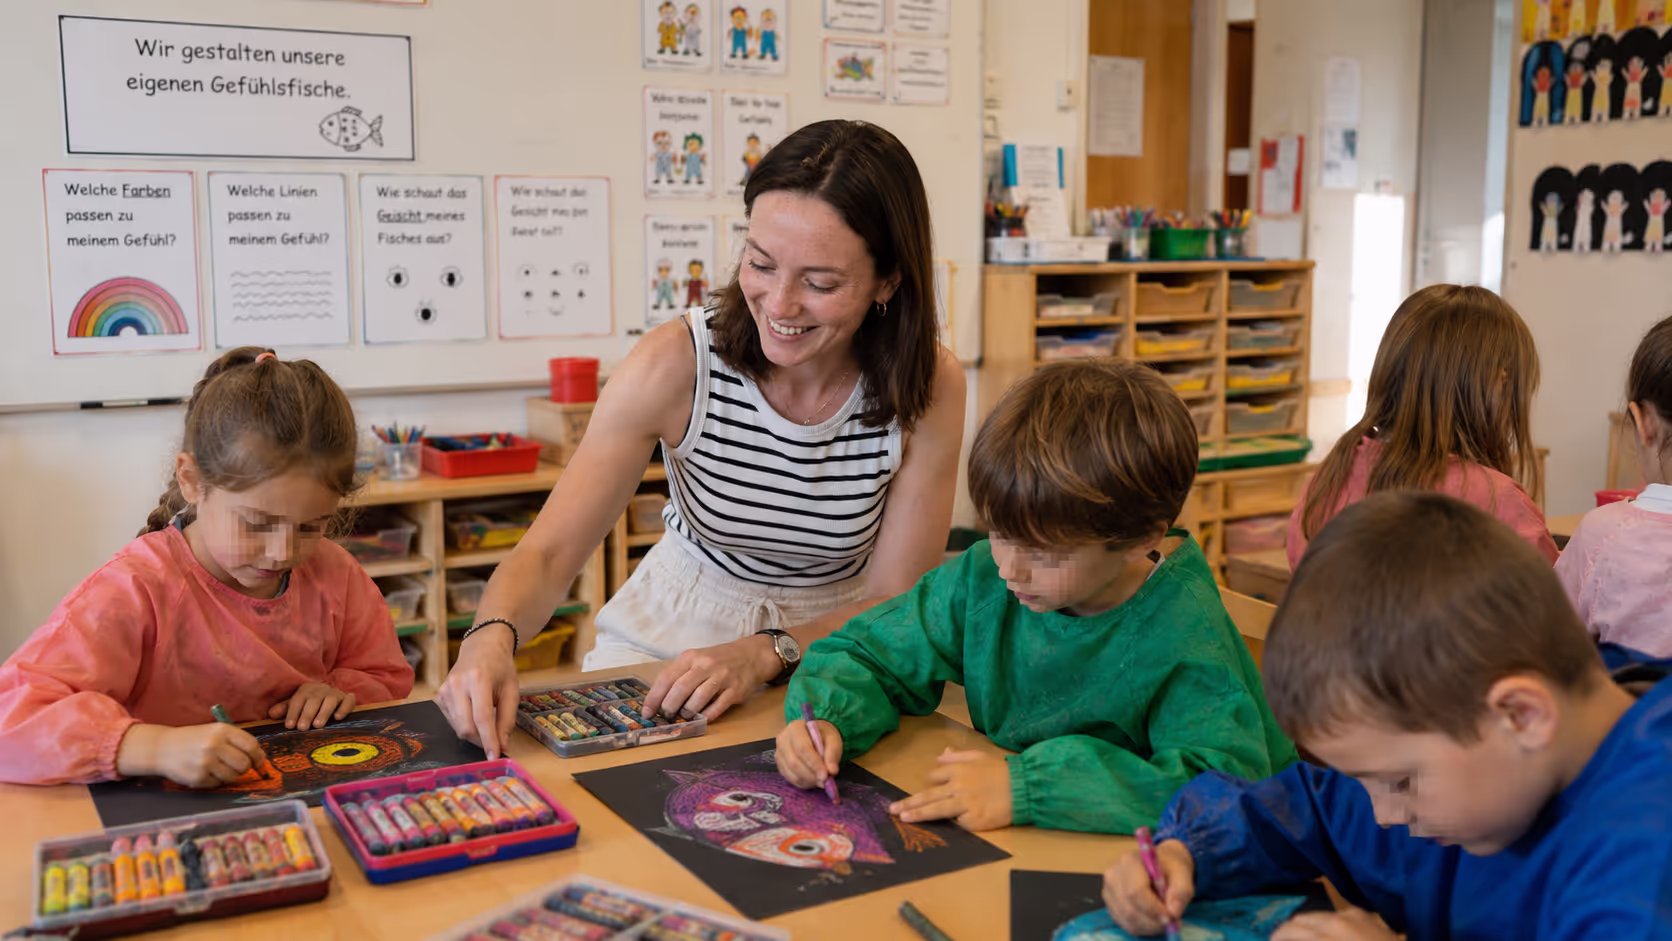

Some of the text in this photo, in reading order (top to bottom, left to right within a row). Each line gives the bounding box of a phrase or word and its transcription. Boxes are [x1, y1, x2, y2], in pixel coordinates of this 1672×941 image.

[134, 38, 346, 66] Wir gestalten unsere
[126, 73, 351, 99] eigenen Gefühlsfische.
[64, 183, 171, 198] Welche Farben
[227, 184, 318, 198] Welche Linien
[376, 186, 467, 199] Wie schaut das
[65, 211, 134, 225] passen zu
[227, 211, 291, 224] passen zu
[425, 212, 466, 222] meines
[67, 233, 177, 247] meinem Gefühl?
[228, 232, 330, 246] meinem Gefühl?
[377, 231, 453, 244] Fisches aus?
